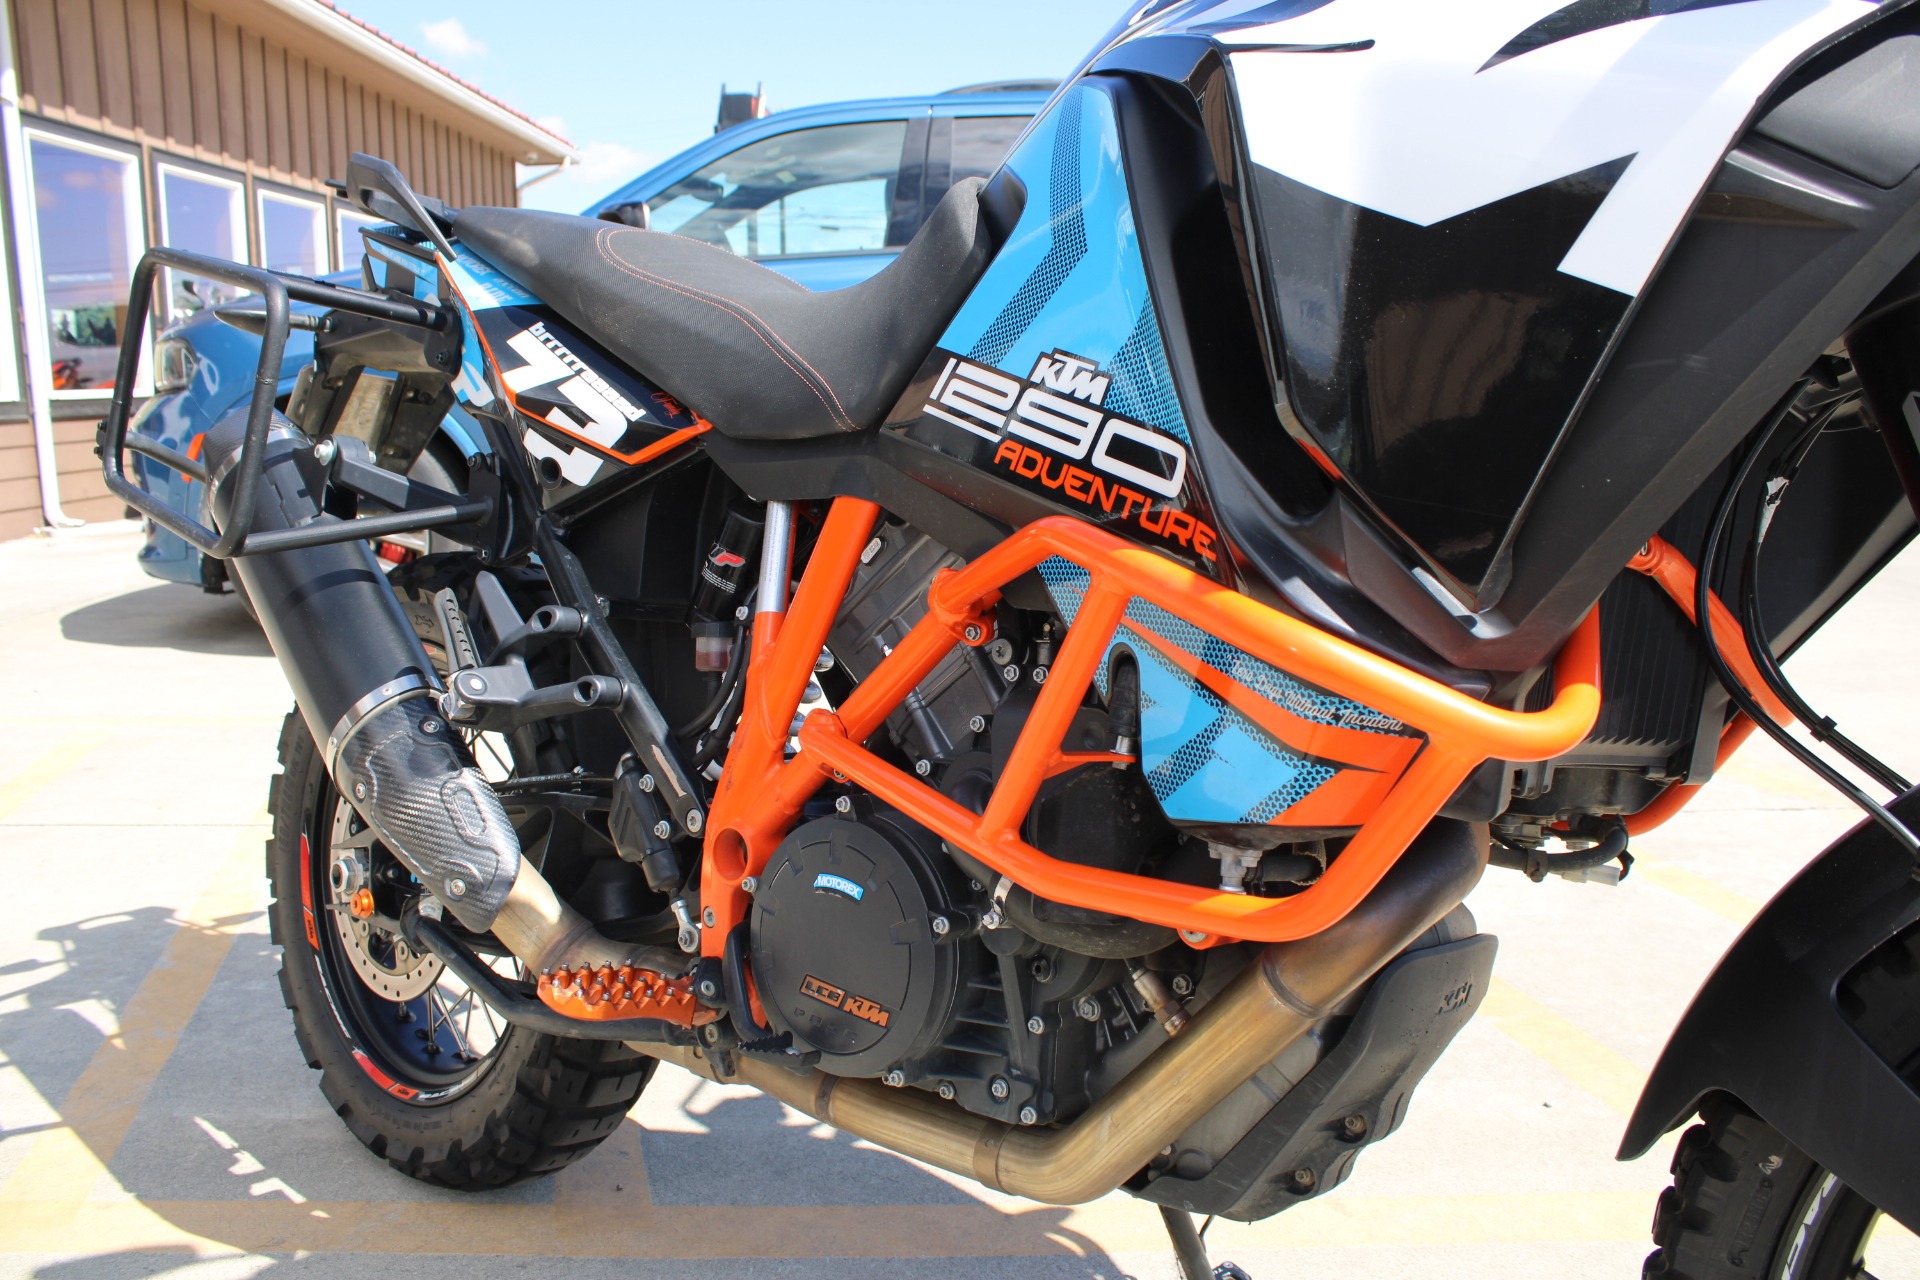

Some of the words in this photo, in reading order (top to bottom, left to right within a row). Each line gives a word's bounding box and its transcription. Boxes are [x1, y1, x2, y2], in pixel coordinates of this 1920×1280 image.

[1030, 352, 1110, 405] KTM
[922, 357, 1187, 498] 1290
[993, 439, 1217, 561] ADVENTURE
[1284, 690, 1337, 720] Without
[1339, 707, 1404, 731] Incident
[816, 874, 860, 899] MOTOREX
[842, 995, 890, 1028] KTM
